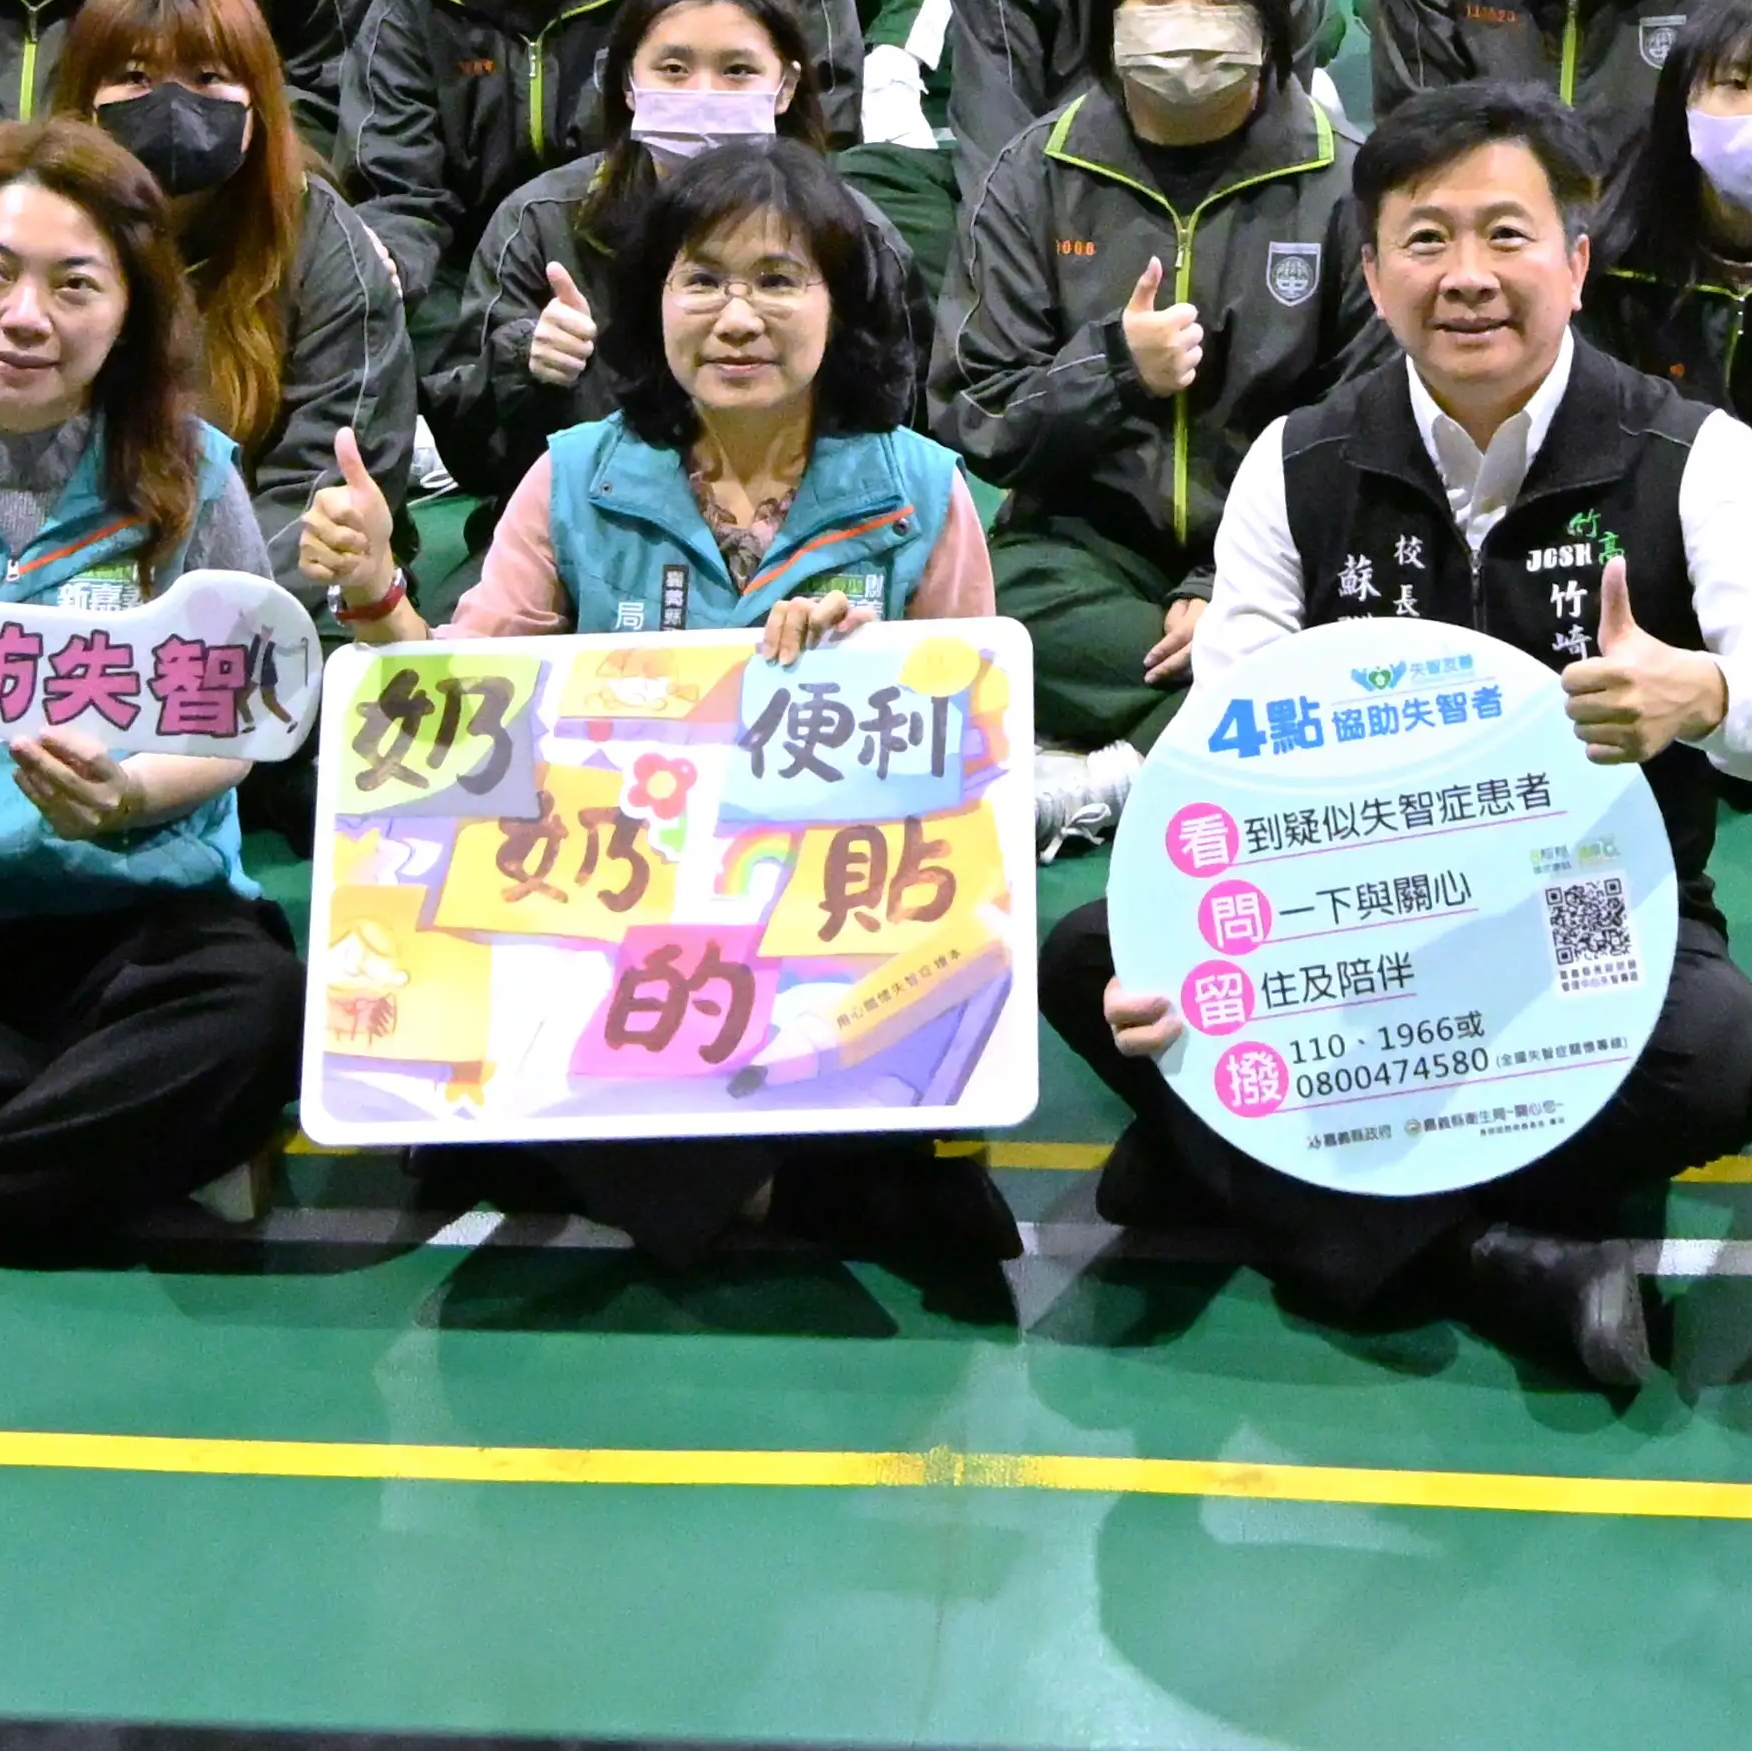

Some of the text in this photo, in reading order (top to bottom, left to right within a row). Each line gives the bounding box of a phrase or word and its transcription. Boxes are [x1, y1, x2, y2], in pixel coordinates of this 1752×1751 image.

[1337, 553, 1382, 621] 蘇
[1393, 533, 1426, 618] 校長
[351, 668, 516, 795] 奶
[742, 682, 950, 783] 便利
[1207, 684, 1504, 759] 4點 協助失智者
[495, 790, 651, 913] 奶
[1179, 813, 1231, 870] 看
[1244, 771, 1553, 855] 到疑似失智症患者
[816, 814, 958, 942] 貼
[1210, 868, 1473, 949] 問 一下與關心
[604, 938, 757, 1064] 的
[1193, 951, 1416, 1029] 留 住及陪伴
[1224, 1052, 1283, 1108] 撥
[1295, 1046, 1490, 1102] 0800474580
